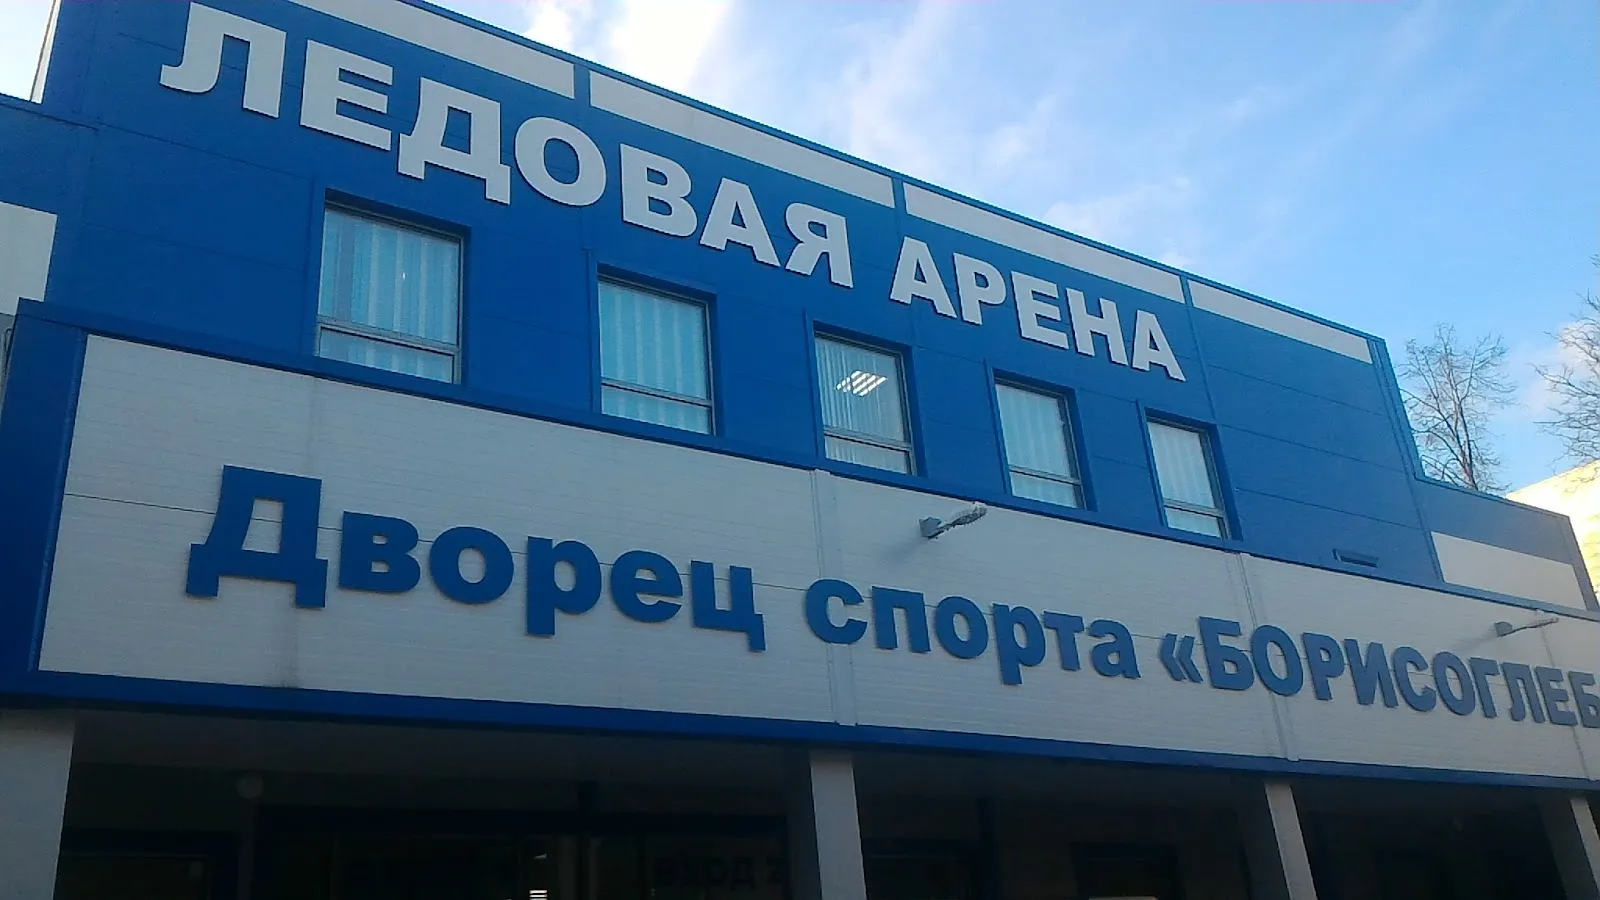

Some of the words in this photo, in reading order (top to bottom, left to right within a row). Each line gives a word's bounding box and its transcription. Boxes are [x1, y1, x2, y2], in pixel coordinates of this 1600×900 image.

[160, 1, 854, 288] ЛЕДОВАЯ
[890, 236, 1187, 382] АРЕНА
[185, 464, 766, 652] Дворец
[804, 578, 1142, 685] спорта
